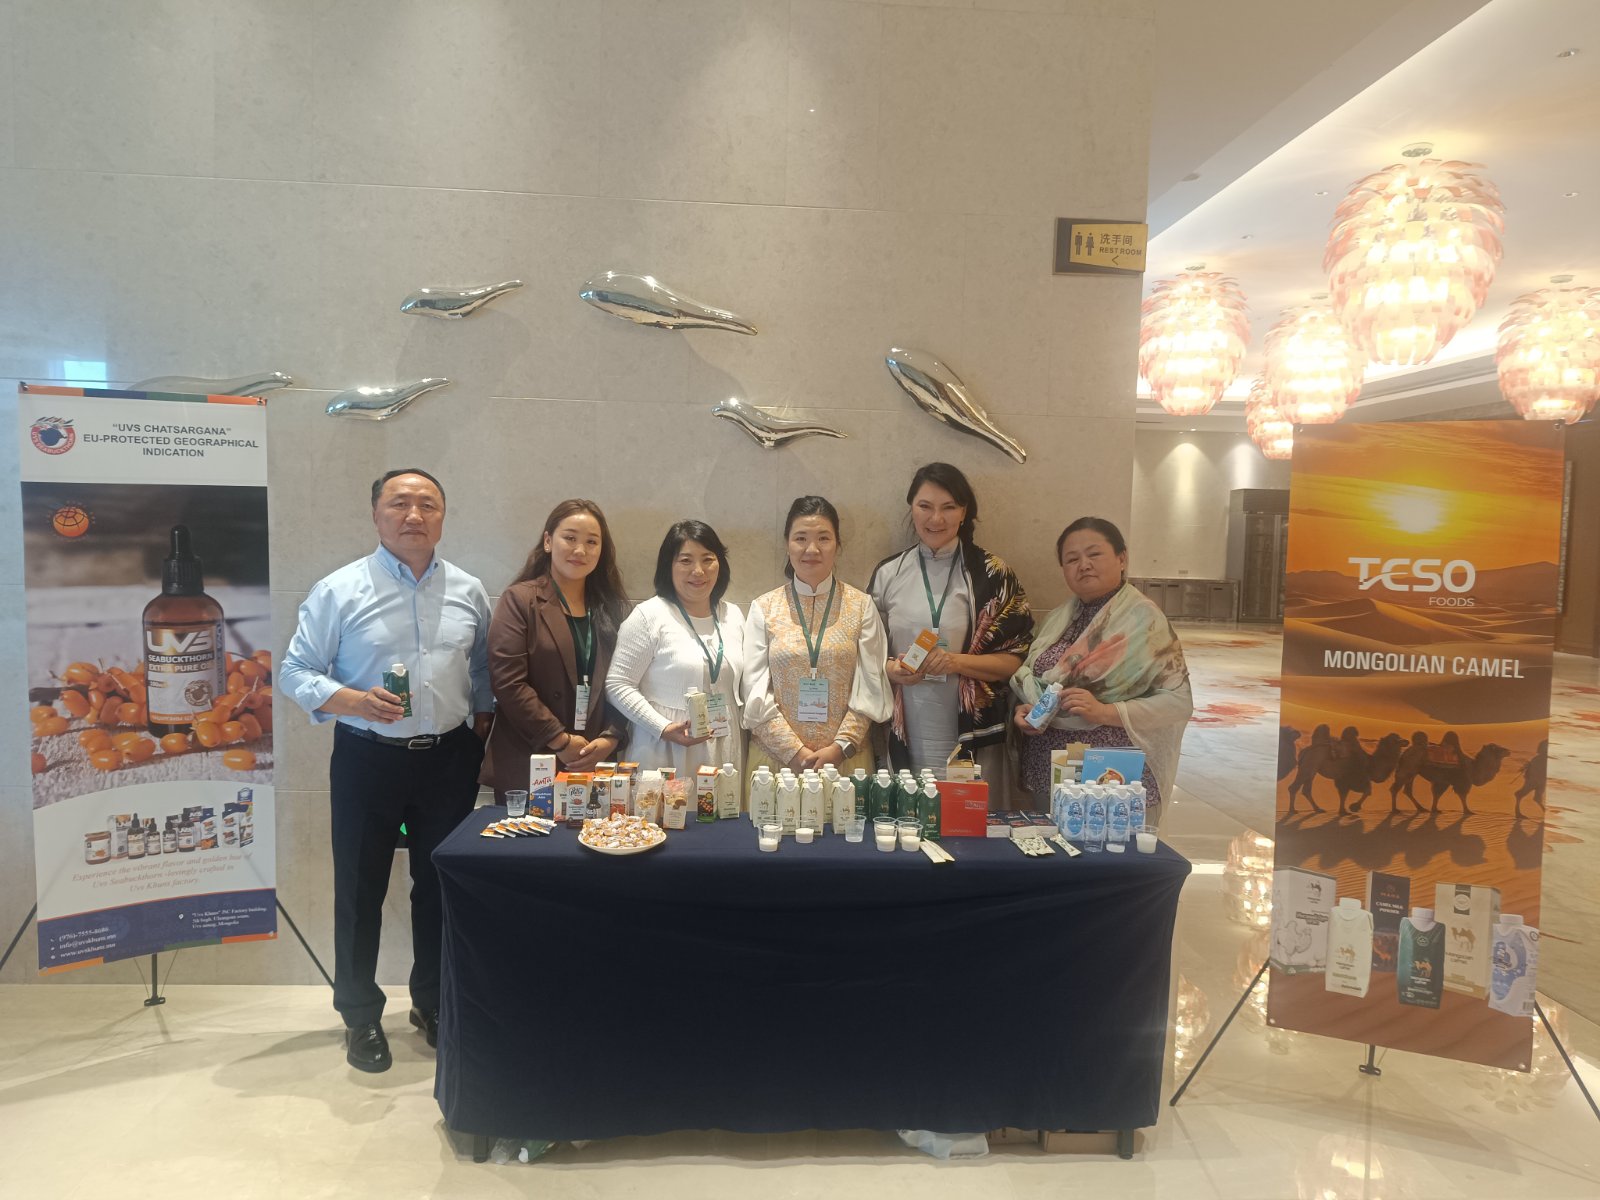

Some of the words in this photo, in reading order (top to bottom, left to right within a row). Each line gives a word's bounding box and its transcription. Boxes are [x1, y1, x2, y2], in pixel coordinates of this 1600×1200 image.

[1099, 233, 1133, 247] 洗手间
[1099, 246, 1142, 257] RESTROOM
[83, 433, 171, 445] EU-PROTECTED
[173, 436, 259, 448] GEOGRAPHICAL
[142, 447, 204, 457] INDICATION
[1348, 556, 1476, 593] TESO
[1428, 596, 1475, 607] FOODS
[146, 630, 210, 653] UVS
[147, 653, 214, 663] SEABUCKTHORN
[1323, 649, 1445, 674] MONGOLIAN
[1452, 656, 1525, 679] CAMEL
[174, 663, 199, 672] PURE
